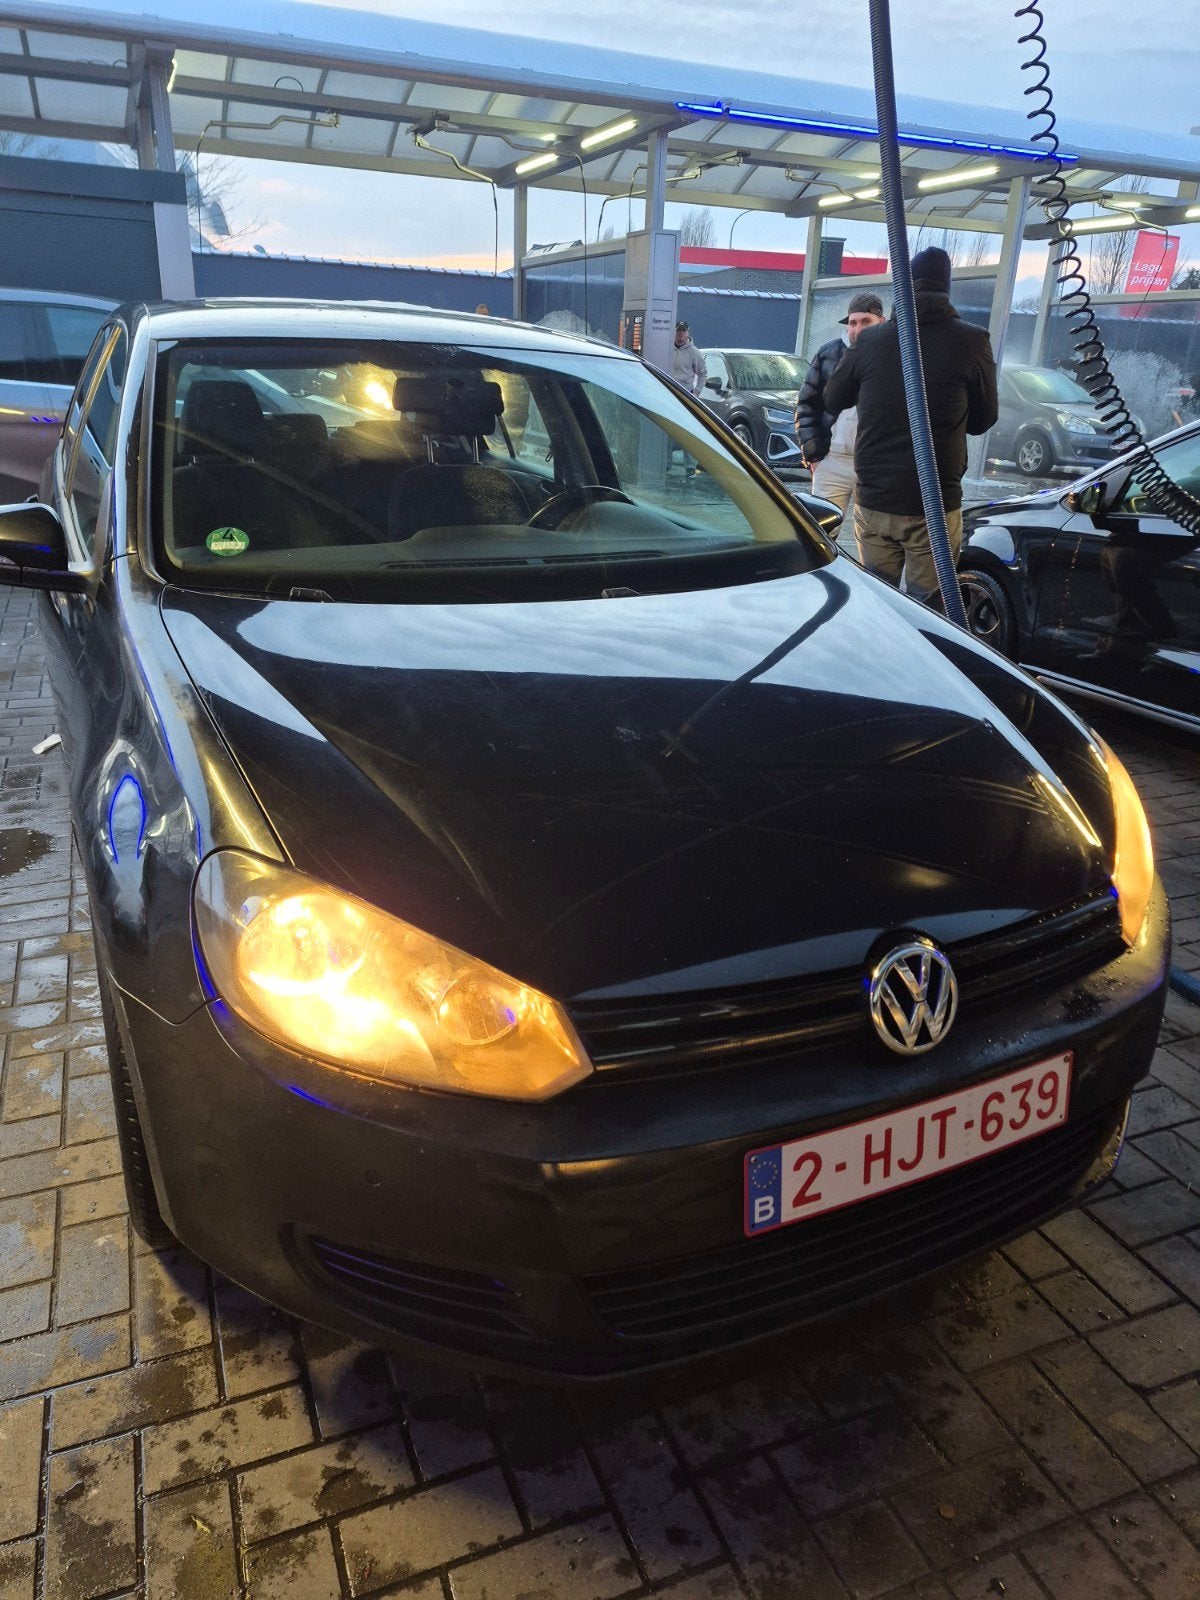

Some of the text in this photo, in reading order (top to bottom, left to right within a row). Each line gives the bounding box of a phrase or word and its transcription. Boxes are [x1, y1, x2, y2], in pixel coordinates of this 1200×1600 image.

[222, 529, 234, 541] 4
[791, 1070, 1060, 1208] 2-HJT-639
[754, 1196, 775, 1224] B
